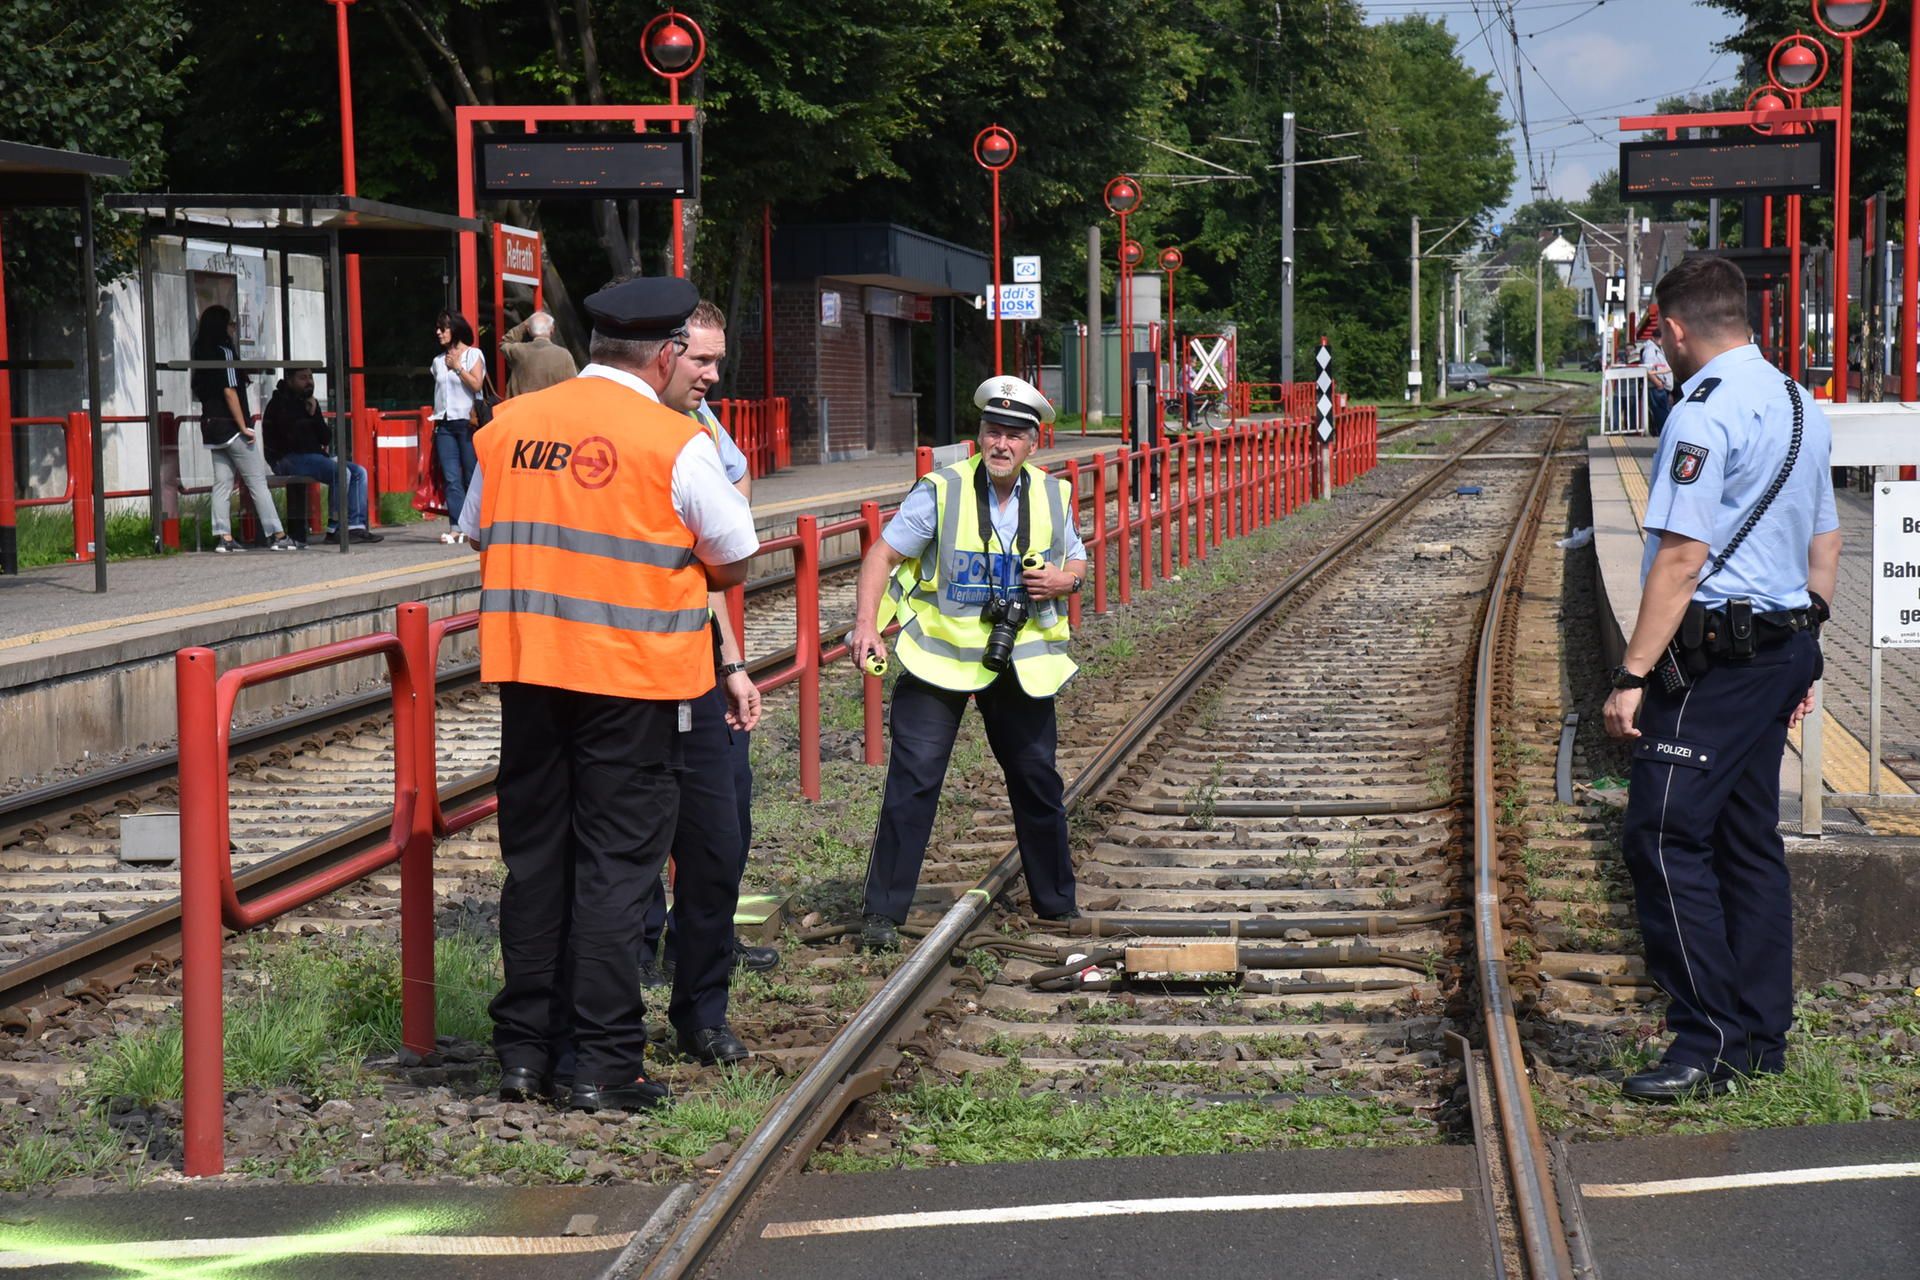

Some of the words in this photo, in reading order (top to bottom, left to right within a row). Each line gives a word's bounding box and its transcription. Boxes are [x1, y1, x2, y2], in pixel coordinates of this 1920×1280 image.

[506, 238, 534, 272] Refrath
[992, 287, 1036, 299] ddi's
[1606, 278, 1626, 301] H
[511, 439, 572, 471] KVB
[1678, 442, 1707, 457] POLIZEI
[1656, 743, 1692, 758] POLIZEI
